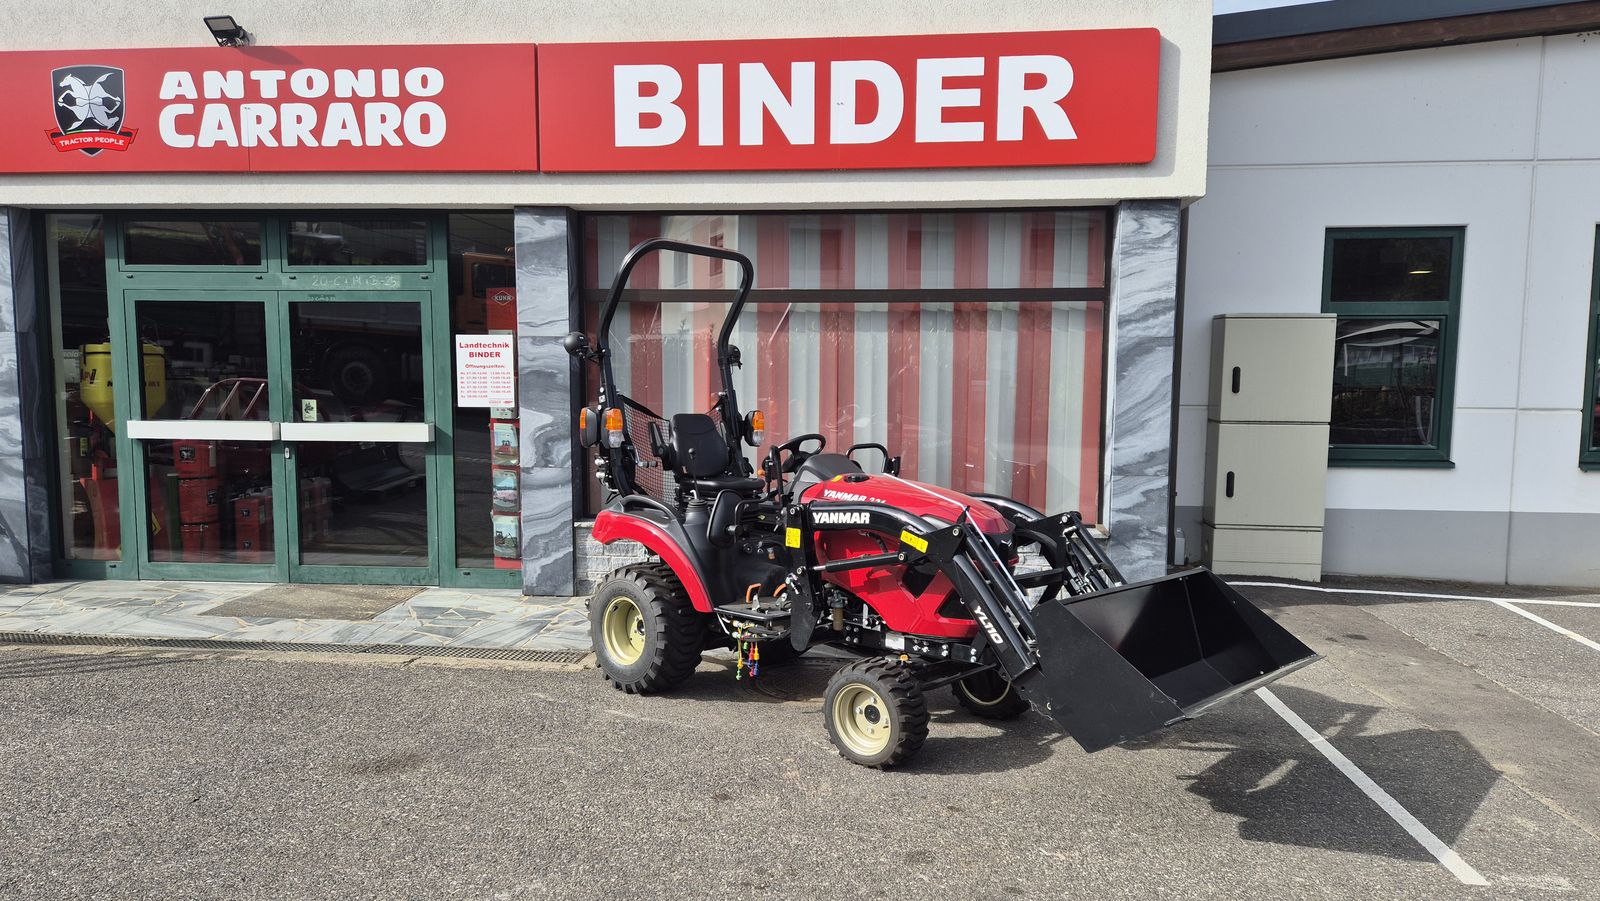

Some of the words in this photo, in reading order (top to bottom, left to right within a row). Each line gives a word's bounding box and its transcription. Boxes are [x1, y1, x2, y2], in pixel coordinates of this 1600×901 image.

[158, 66, 445, 100] ANTONIO
[613, 55, 1078, 147] BINDER
[158, 101, 447, 148] CARRARO
[59, 137, 94, 147] TRACTOR
[94, 137, 124, 146] PEOPLE
[823, 489, 867, 502] YANMAR
[812, 512, 871, 524] YANMAR
[974, 605, 1004, 644] YL110
